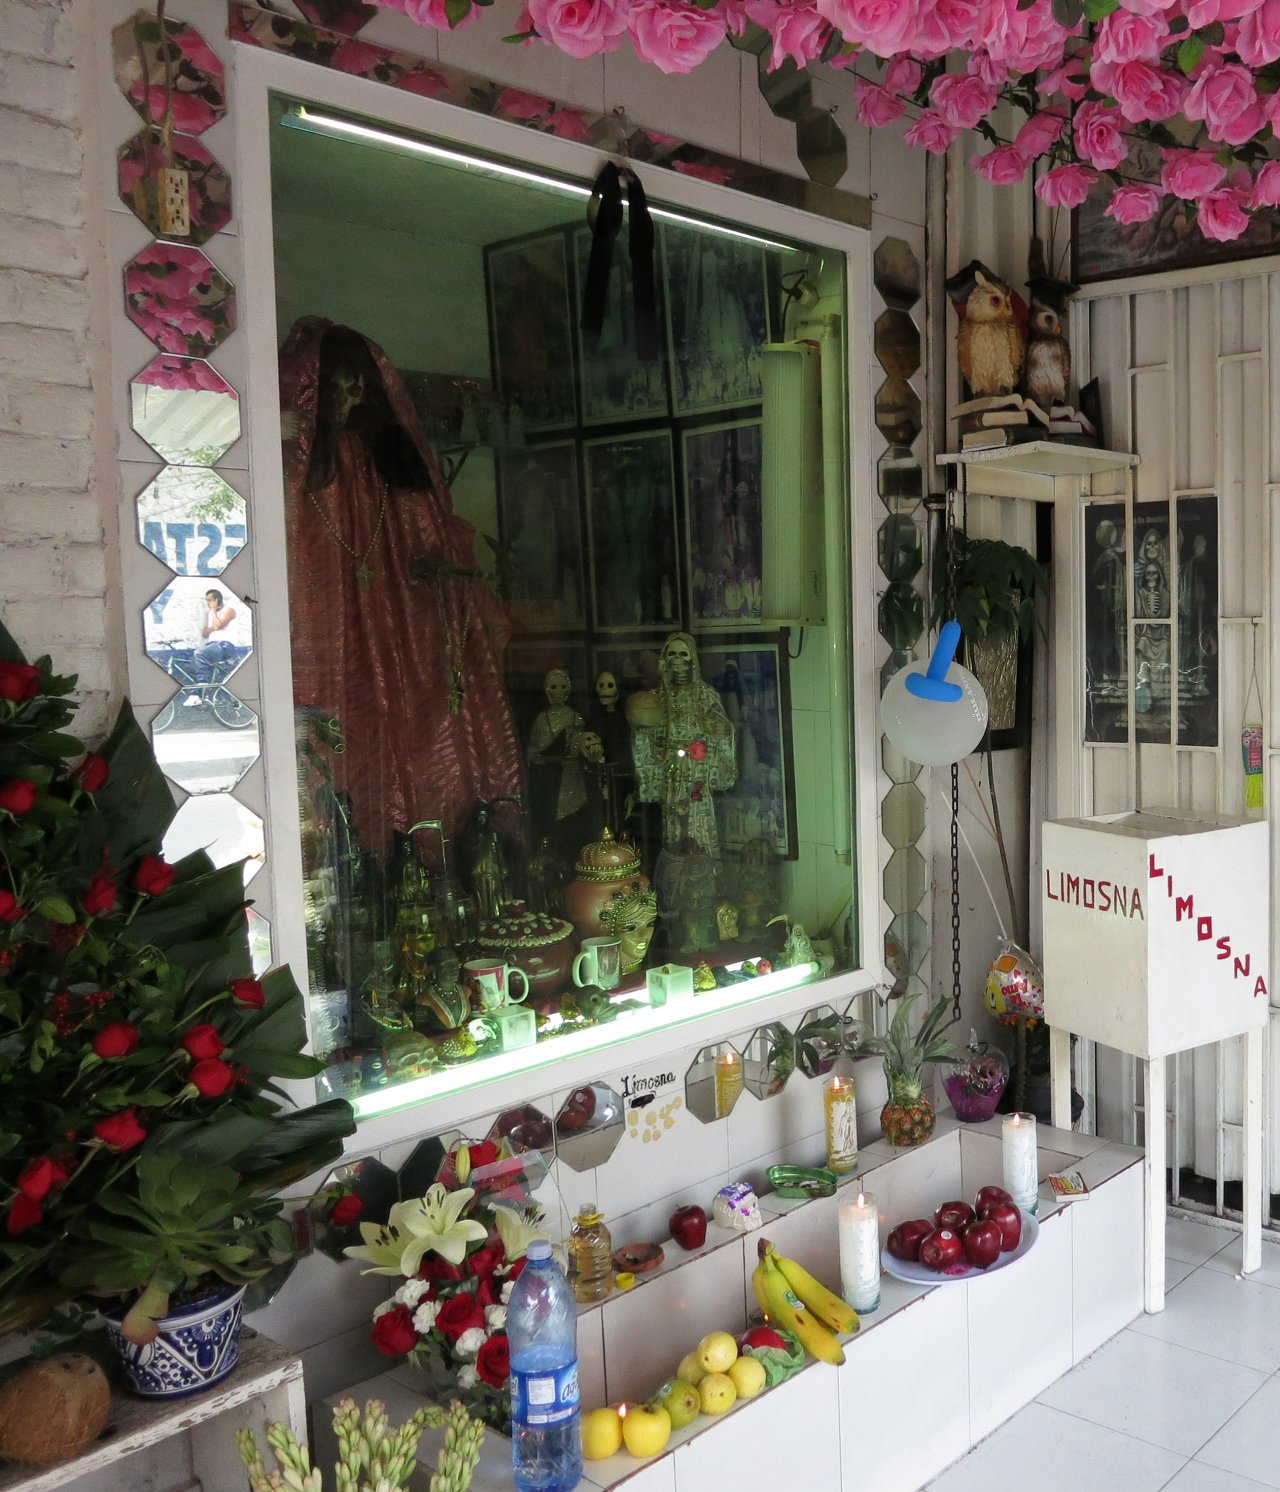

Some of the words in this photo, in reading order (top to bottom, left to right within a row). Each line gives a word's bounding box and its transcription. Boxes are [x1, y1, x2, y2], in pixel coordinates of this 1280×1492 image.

[1046, 869, 1144, 921] LIMOSNA
[1149, 852, 1268, 998] LIMOSNA
[620, 1072, 676, 1098] Limosna
